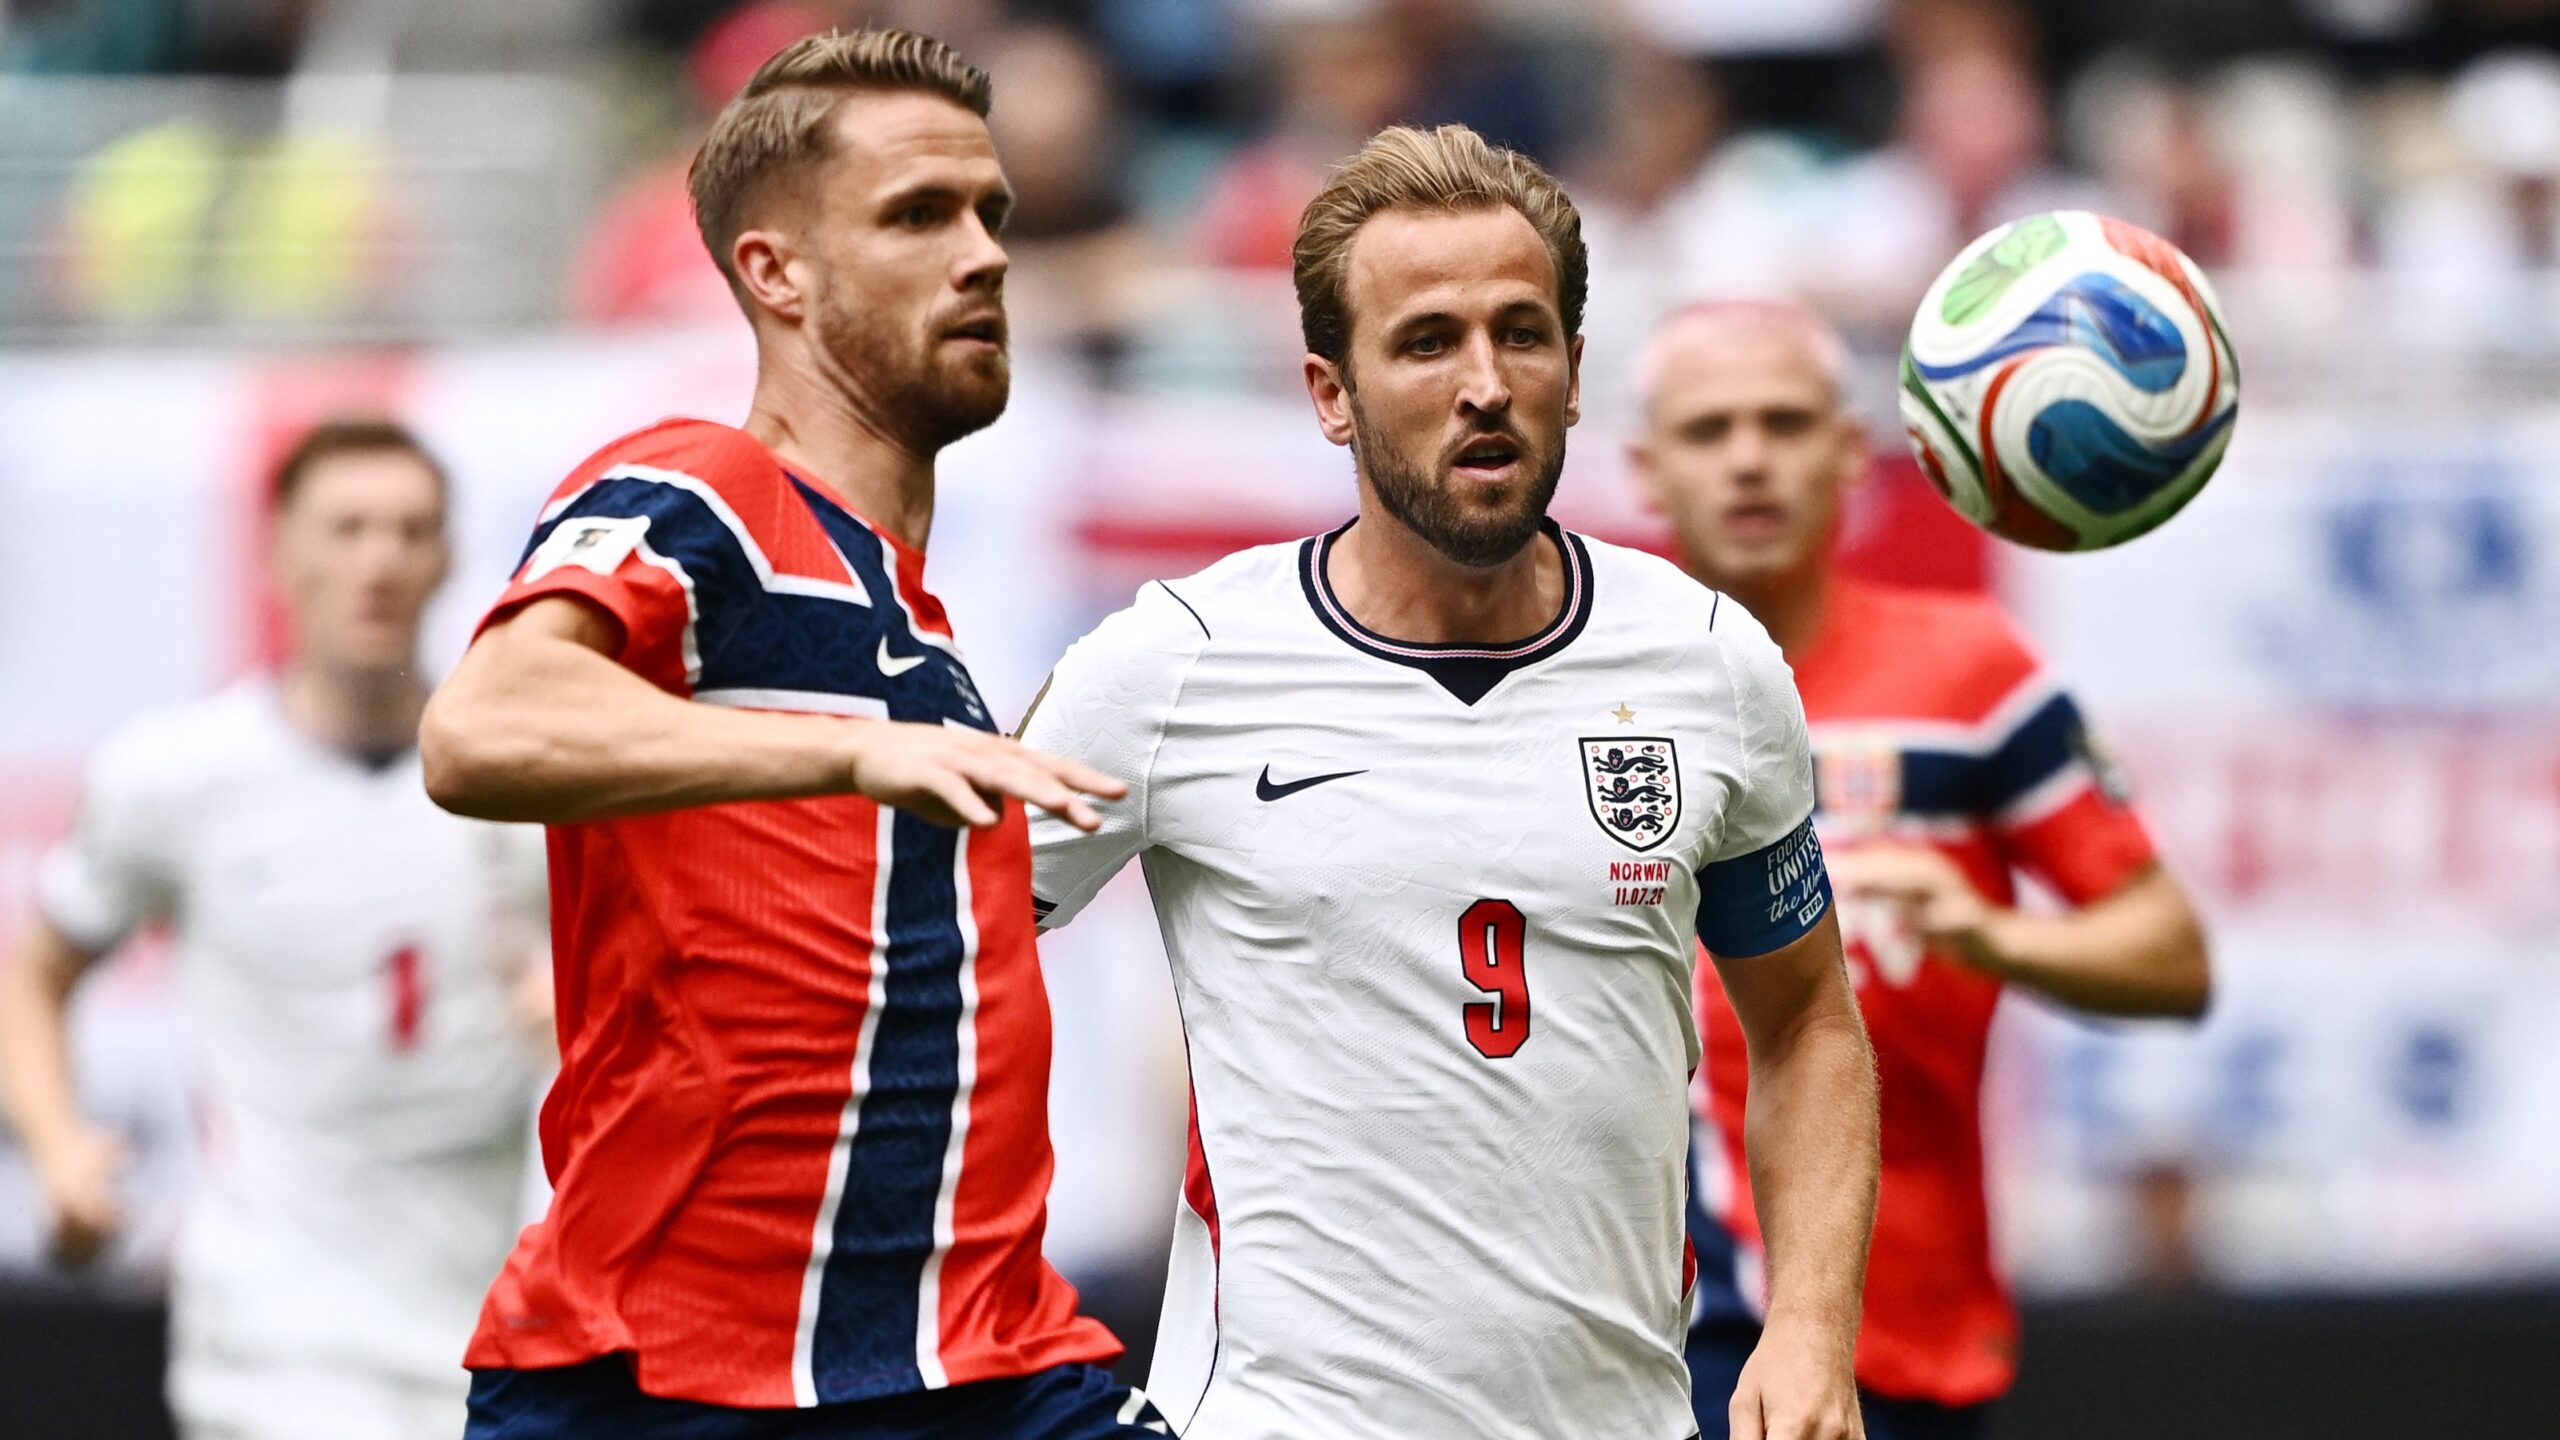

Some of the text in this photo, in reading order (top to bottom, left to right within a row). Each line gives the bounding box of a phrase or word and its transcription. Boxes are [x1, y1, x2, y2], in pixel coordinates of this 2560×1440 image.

[1767, 817, 1811, 871] FOOTBA
[1610, 862, 1671, 881] NORWAY
[1768, 825, 1819, 896] UNITES
[1615, 887, 1664, 906] 11.07.26
[1765, 894, 1800, 923] the
[1800, 897, 1823, 922] FIFA
[1458, 898, 1530, 1059] 9
